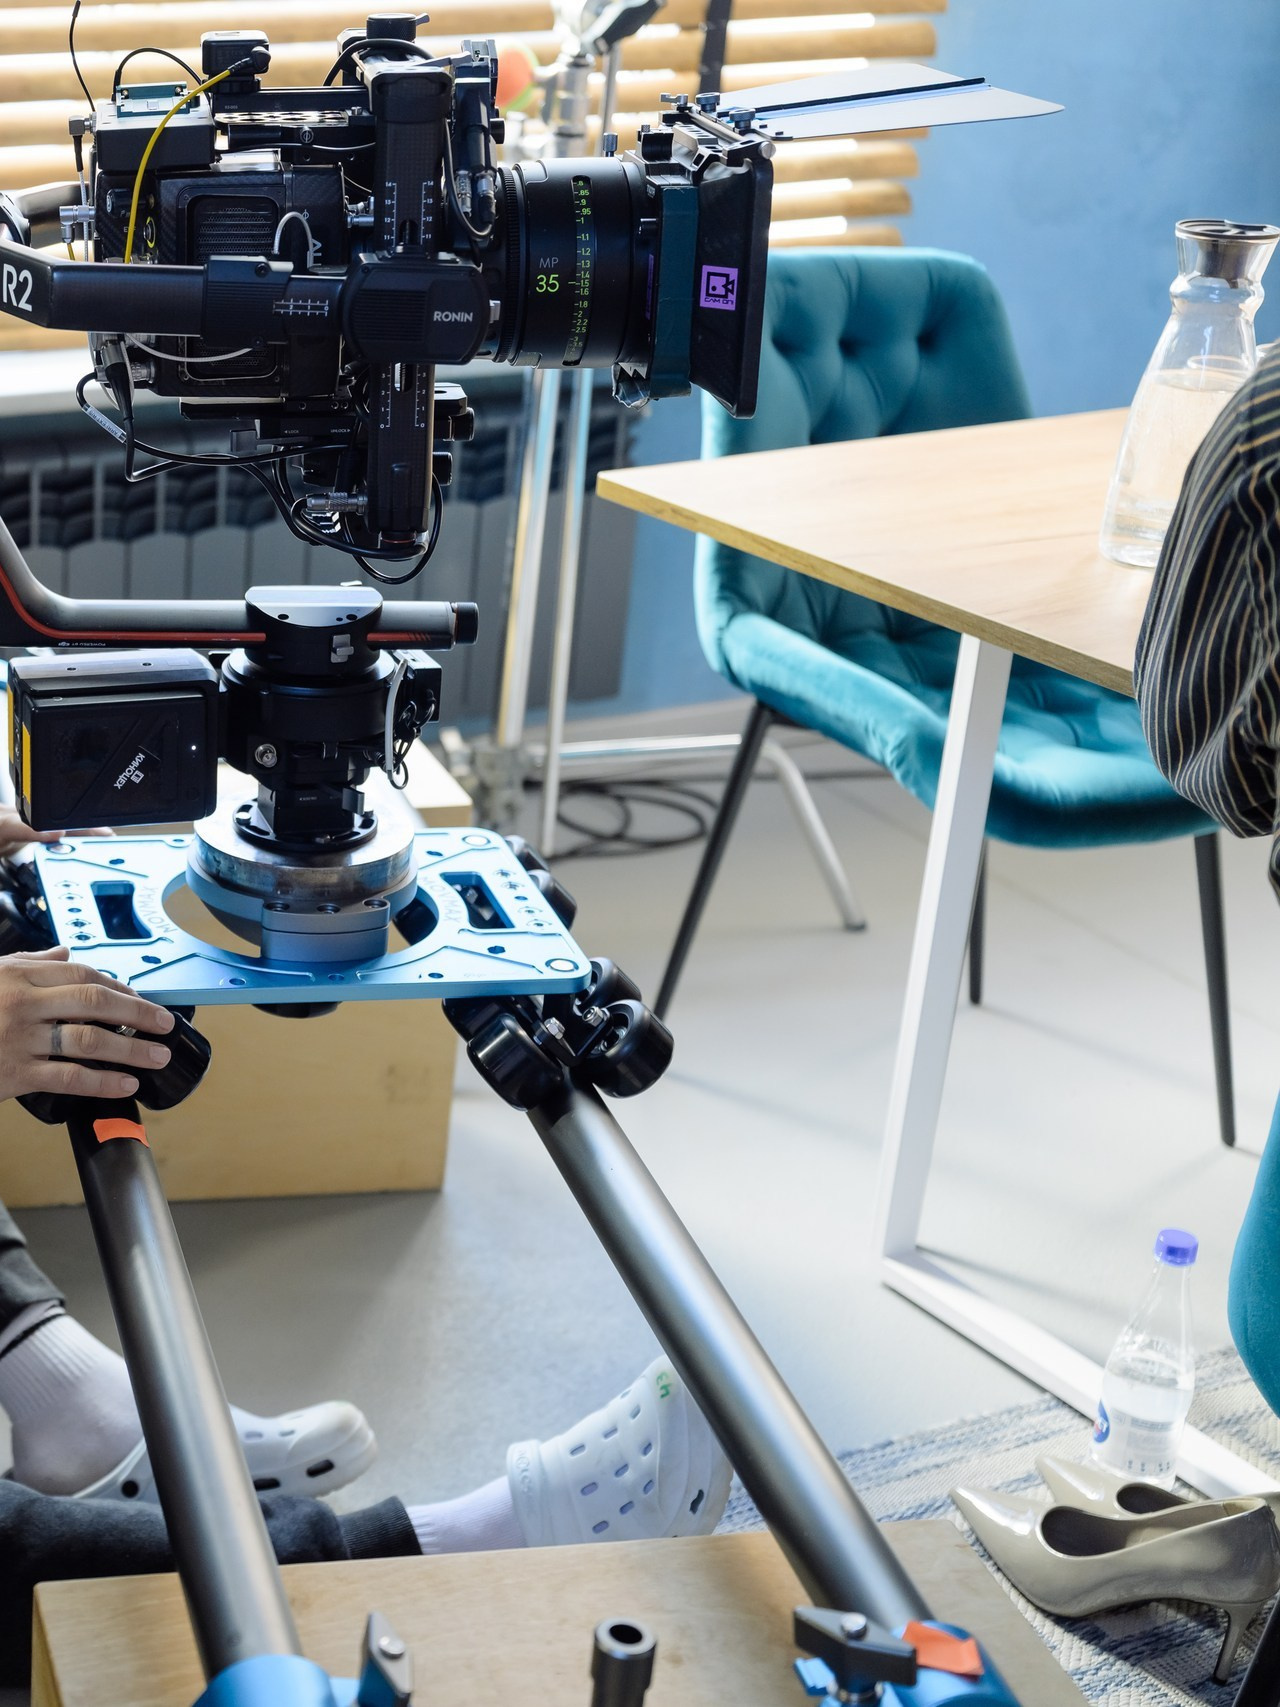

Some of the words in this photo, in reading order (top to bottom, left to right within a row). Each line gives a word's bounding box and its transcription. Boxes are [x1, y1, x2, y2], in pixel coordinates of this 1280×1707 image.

[539, 256, 559, 268] MP
[2, 263, 33, 312] R2
[536, 274, 560, 292] 35
[433, 310, 474, 322] RONIN
[114, 752, 145, 789] КИНОЦЕХ
